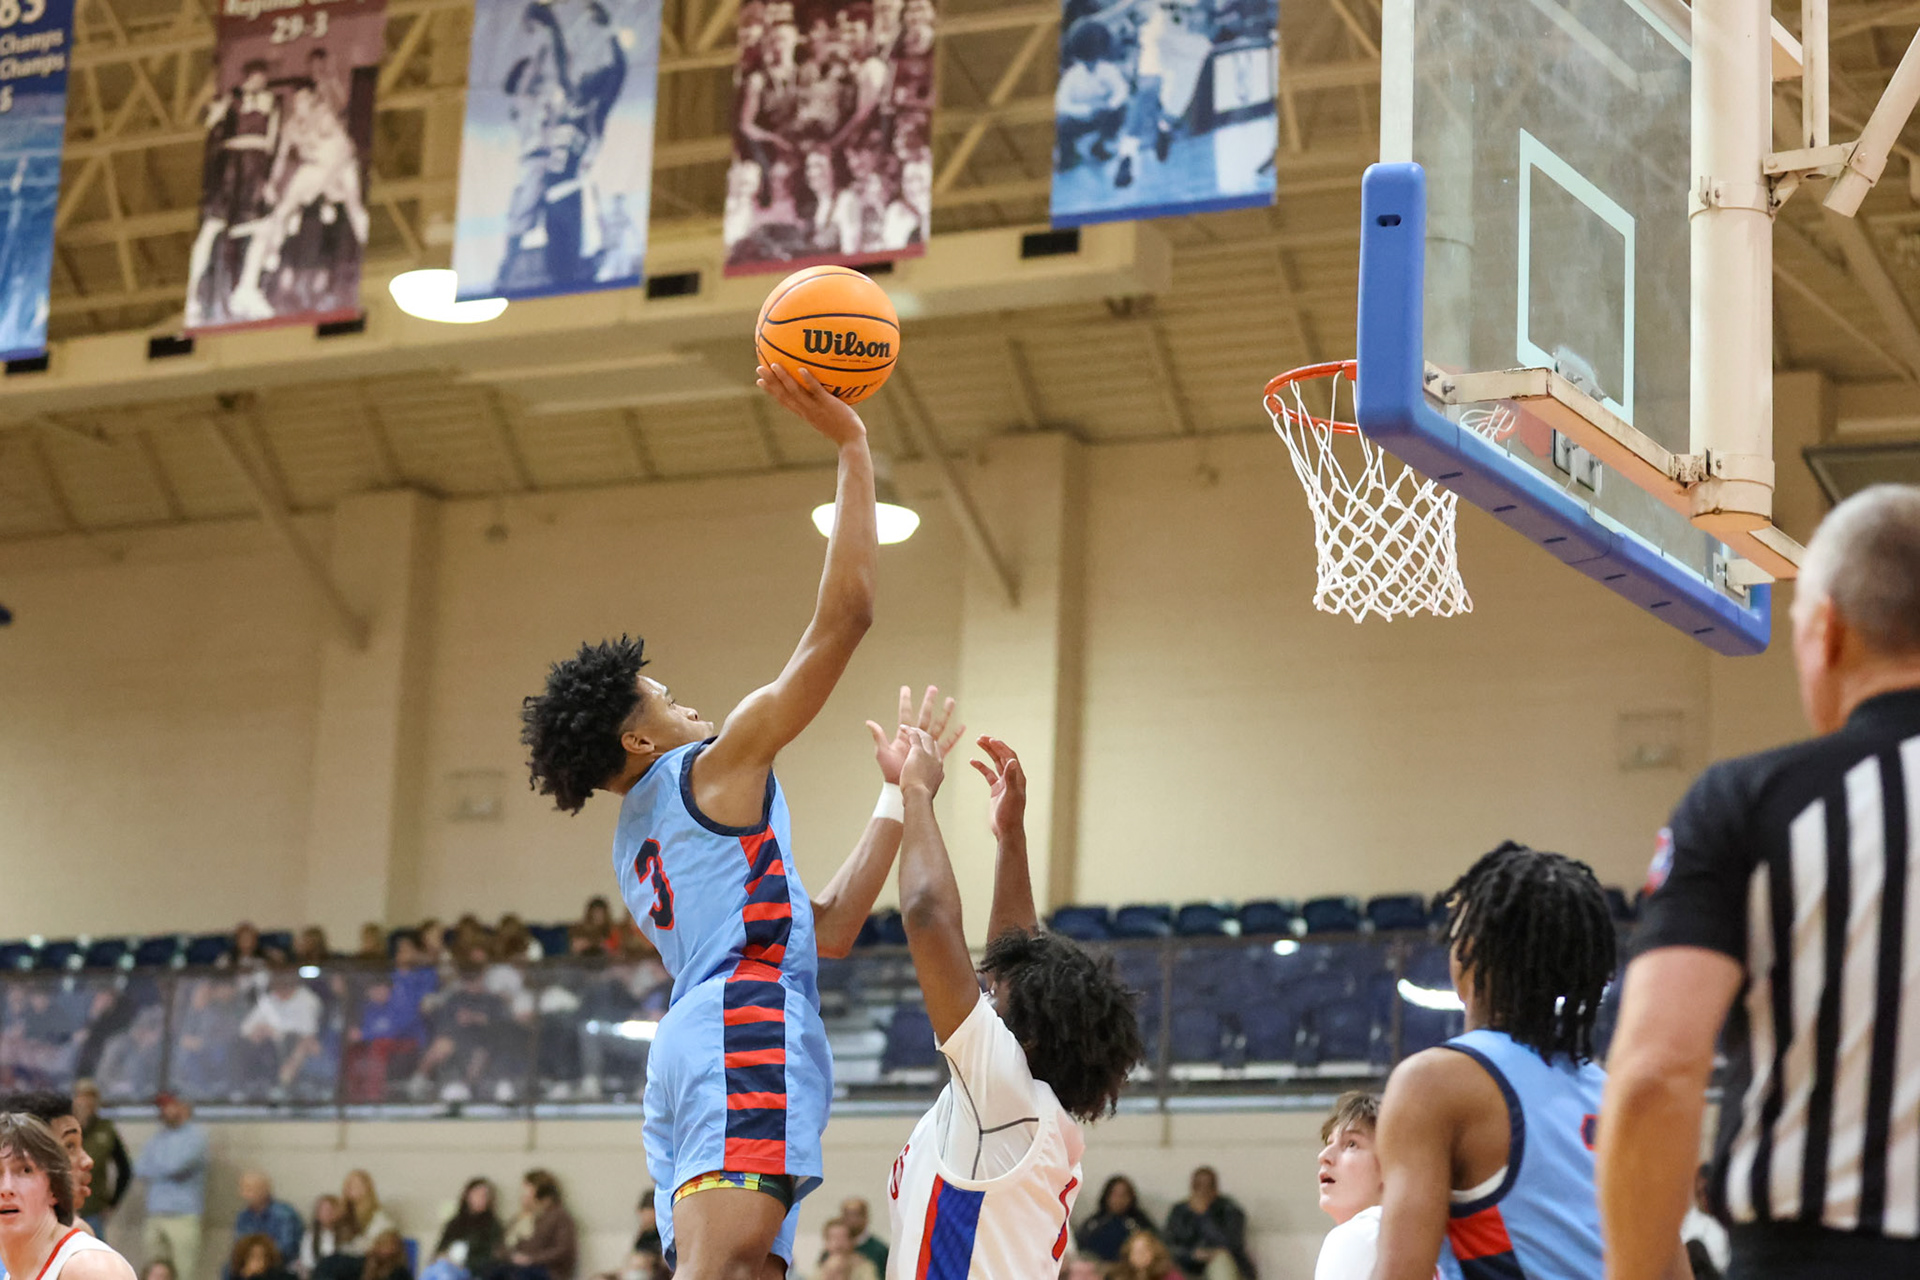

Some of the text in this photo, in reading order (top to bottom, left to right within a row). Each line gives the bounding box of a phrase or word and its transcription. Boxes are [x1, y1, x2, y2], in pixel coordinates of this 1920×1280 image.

[222, 0, 304, 20] Region
[0, 28, 64, 57] Champs
[0, 53, 65, 81] Champs
[802, 328, 891, 358] Wilson
[634, 837, 674, 931] 3
